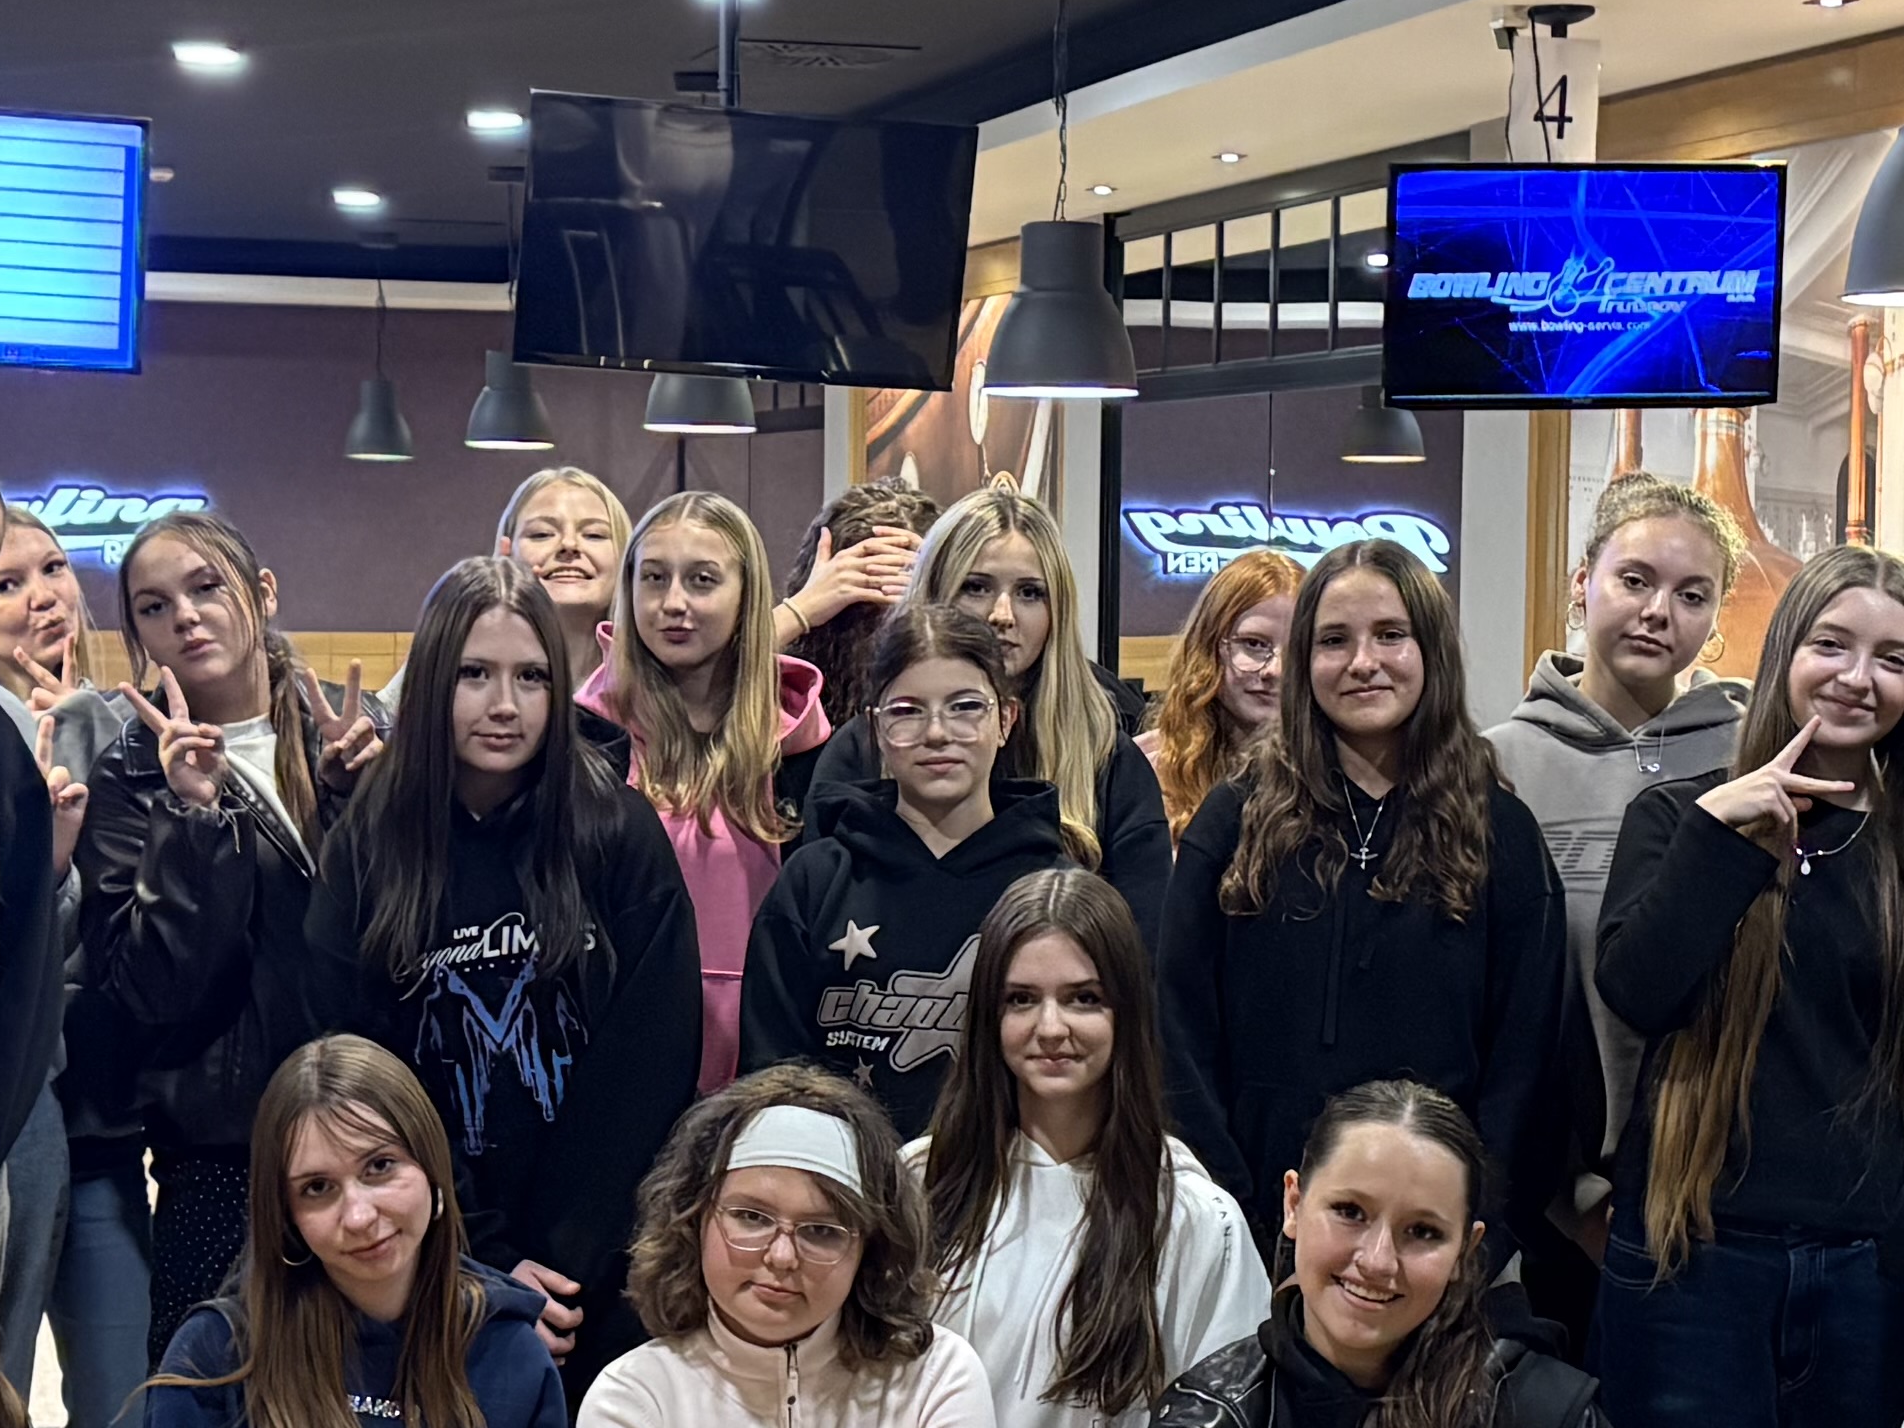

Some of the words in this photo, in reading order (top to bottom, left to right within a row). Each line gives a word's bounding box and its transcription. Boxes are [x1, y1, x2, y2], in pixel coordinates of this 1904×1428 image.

[1533, 74, 1573, 140] 4
[1407, 271, 1554, 299] BOWLING
[1601, 269, 1760, 297] CENTRUM
[453, 925, 480, 941] LIVE
[483, 923, 597, 959] LIMS
